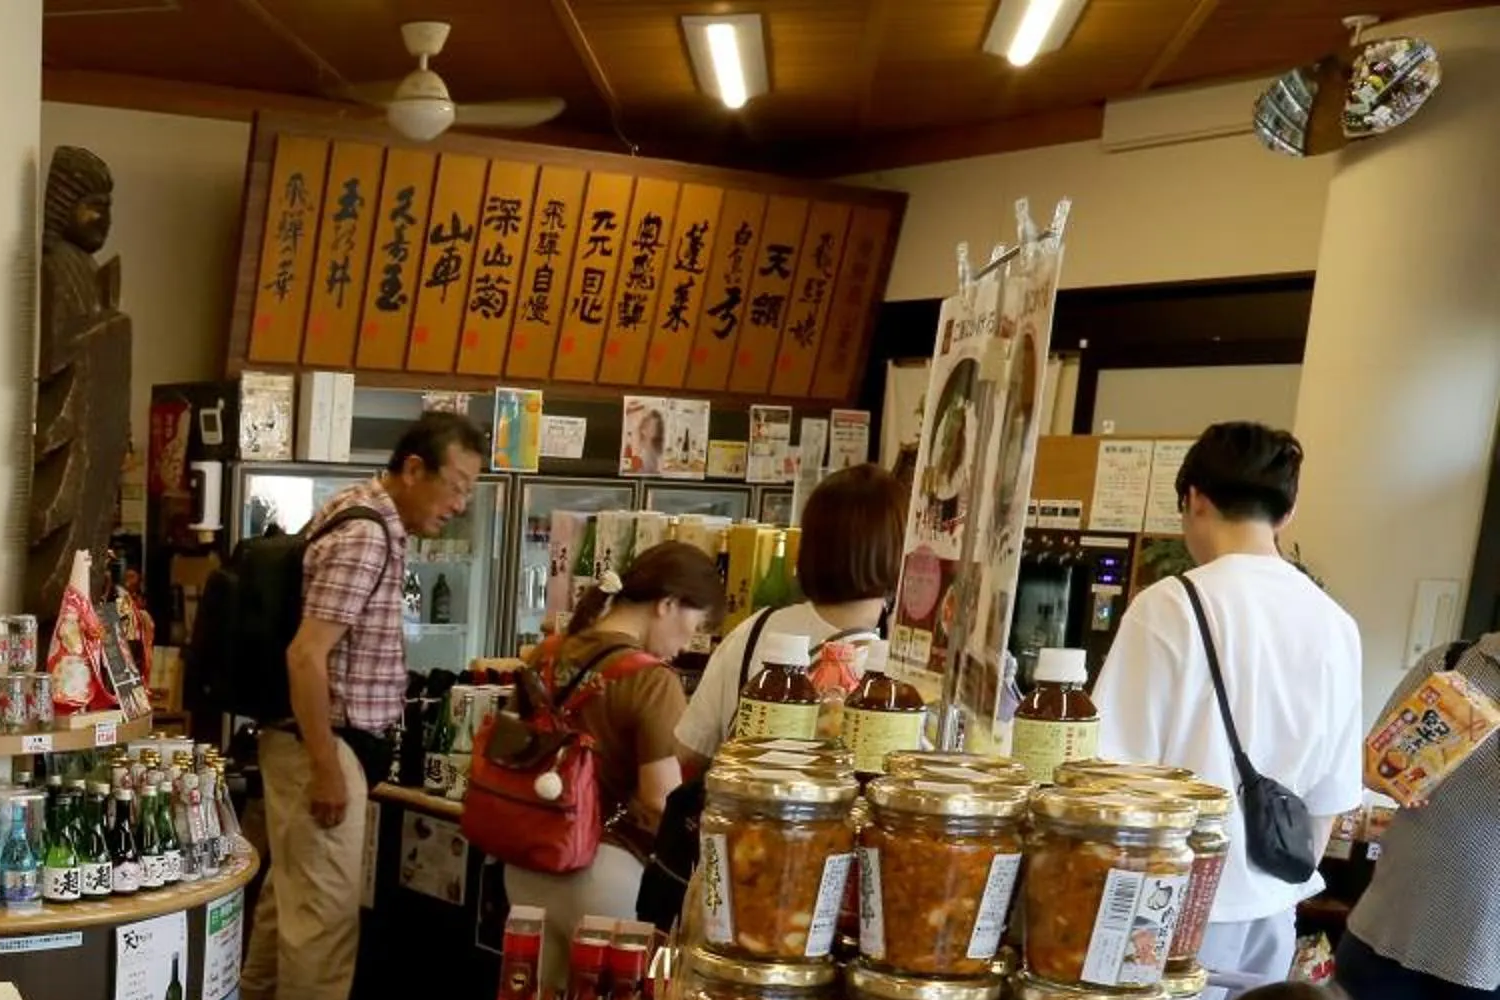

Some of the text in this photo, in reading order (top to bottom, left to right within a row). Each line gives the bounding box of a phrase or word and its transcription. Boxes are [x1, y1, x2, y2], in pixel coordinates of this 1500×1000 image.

[425, 211, 474, 305] 山車
[470, 197, 522, 320] 深山菊
[521, 200, 566, 326] 飛騨自慢
[615, 211, 665, 332] 奥飛騨
[750, 243, 795, 330] 天領
